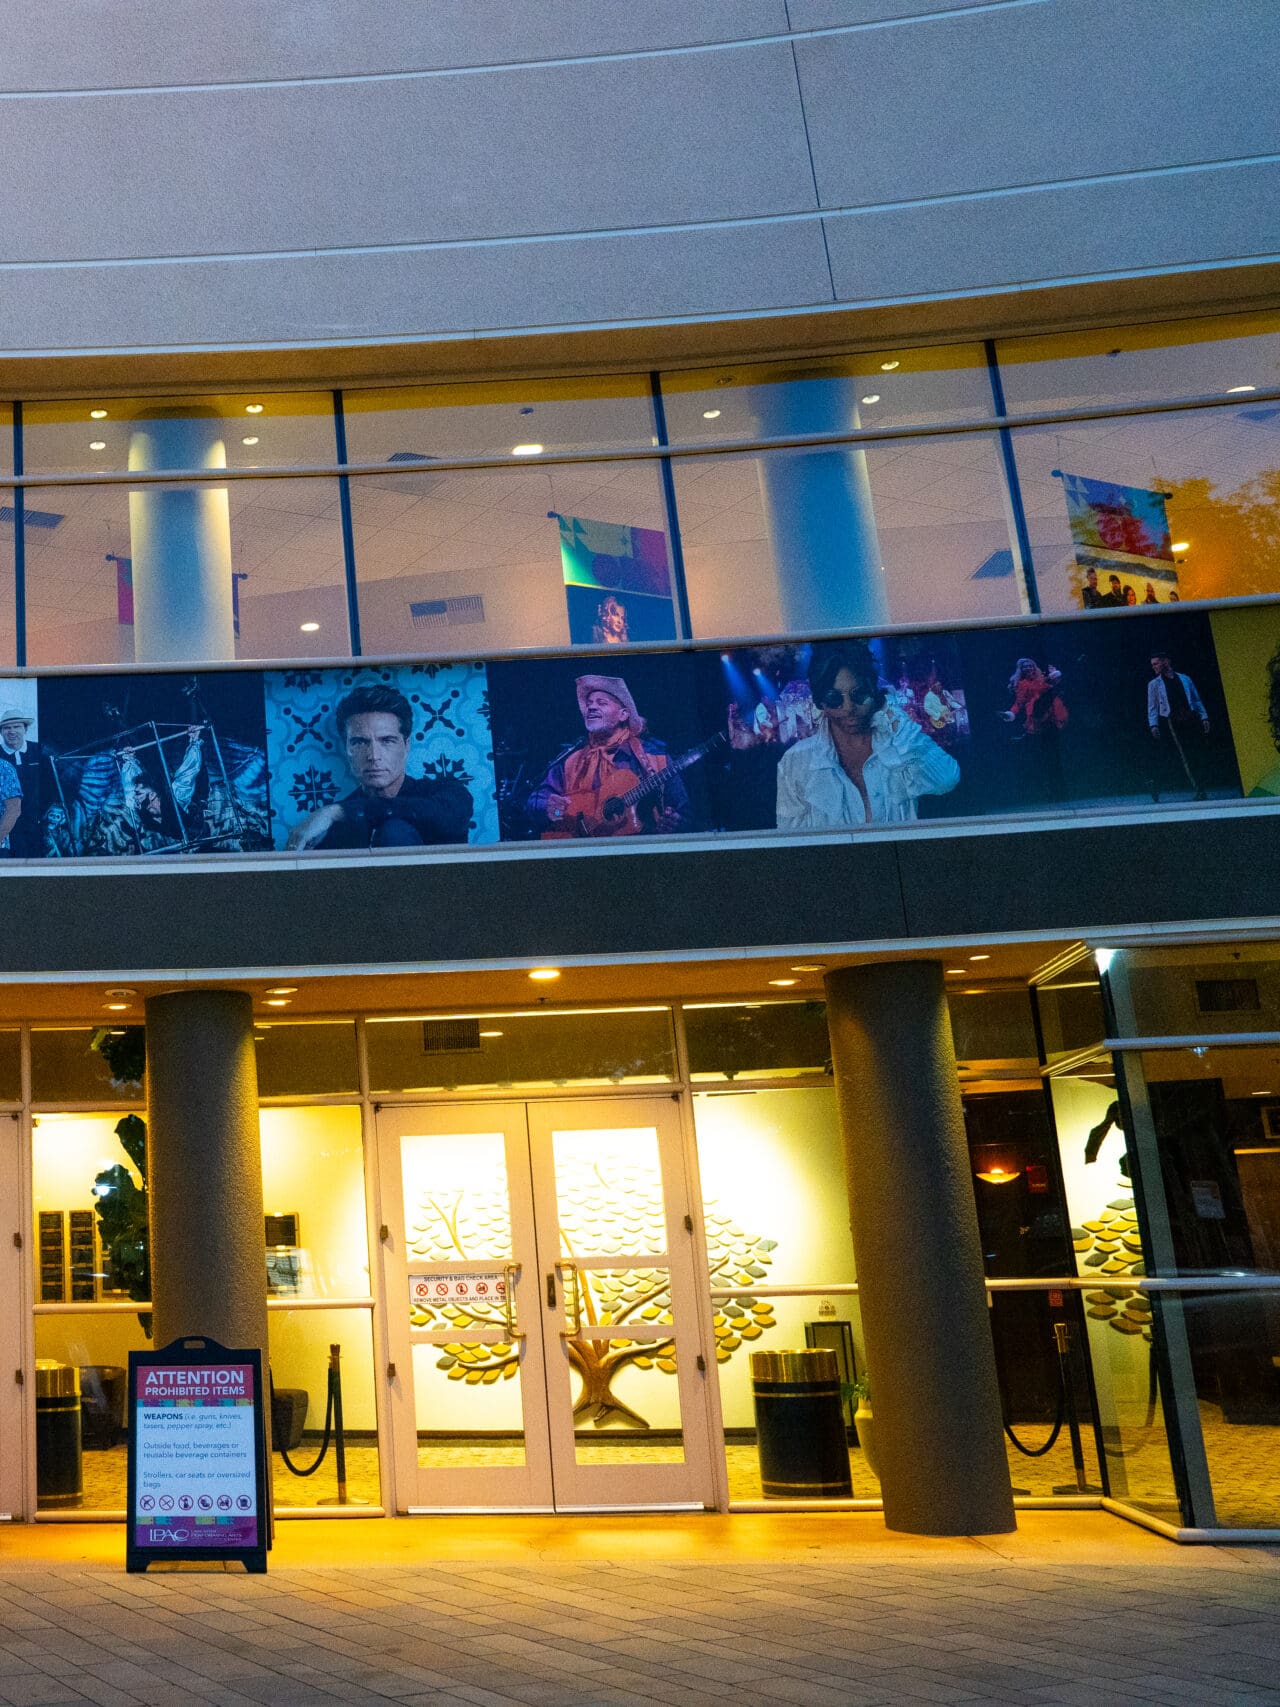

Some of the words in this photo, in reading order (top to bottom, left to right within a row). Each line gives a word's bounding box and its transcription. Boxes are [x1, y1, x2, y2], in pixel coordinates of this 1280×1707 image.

[146, 1370, 244, 1385] ATTENTION
[145, 1386, 210, 1396] PROHIBITED
[212, 1386, 245, 1395] ITEMS
[198, 1414, 218, 1422] guns,
[173, 1442, 192, 1450] food,
[193, 1442, 230, 1450] beverages
[175, 1452, 208, 1460] beverage
[150, 1528, 190, 1542] LPAC
